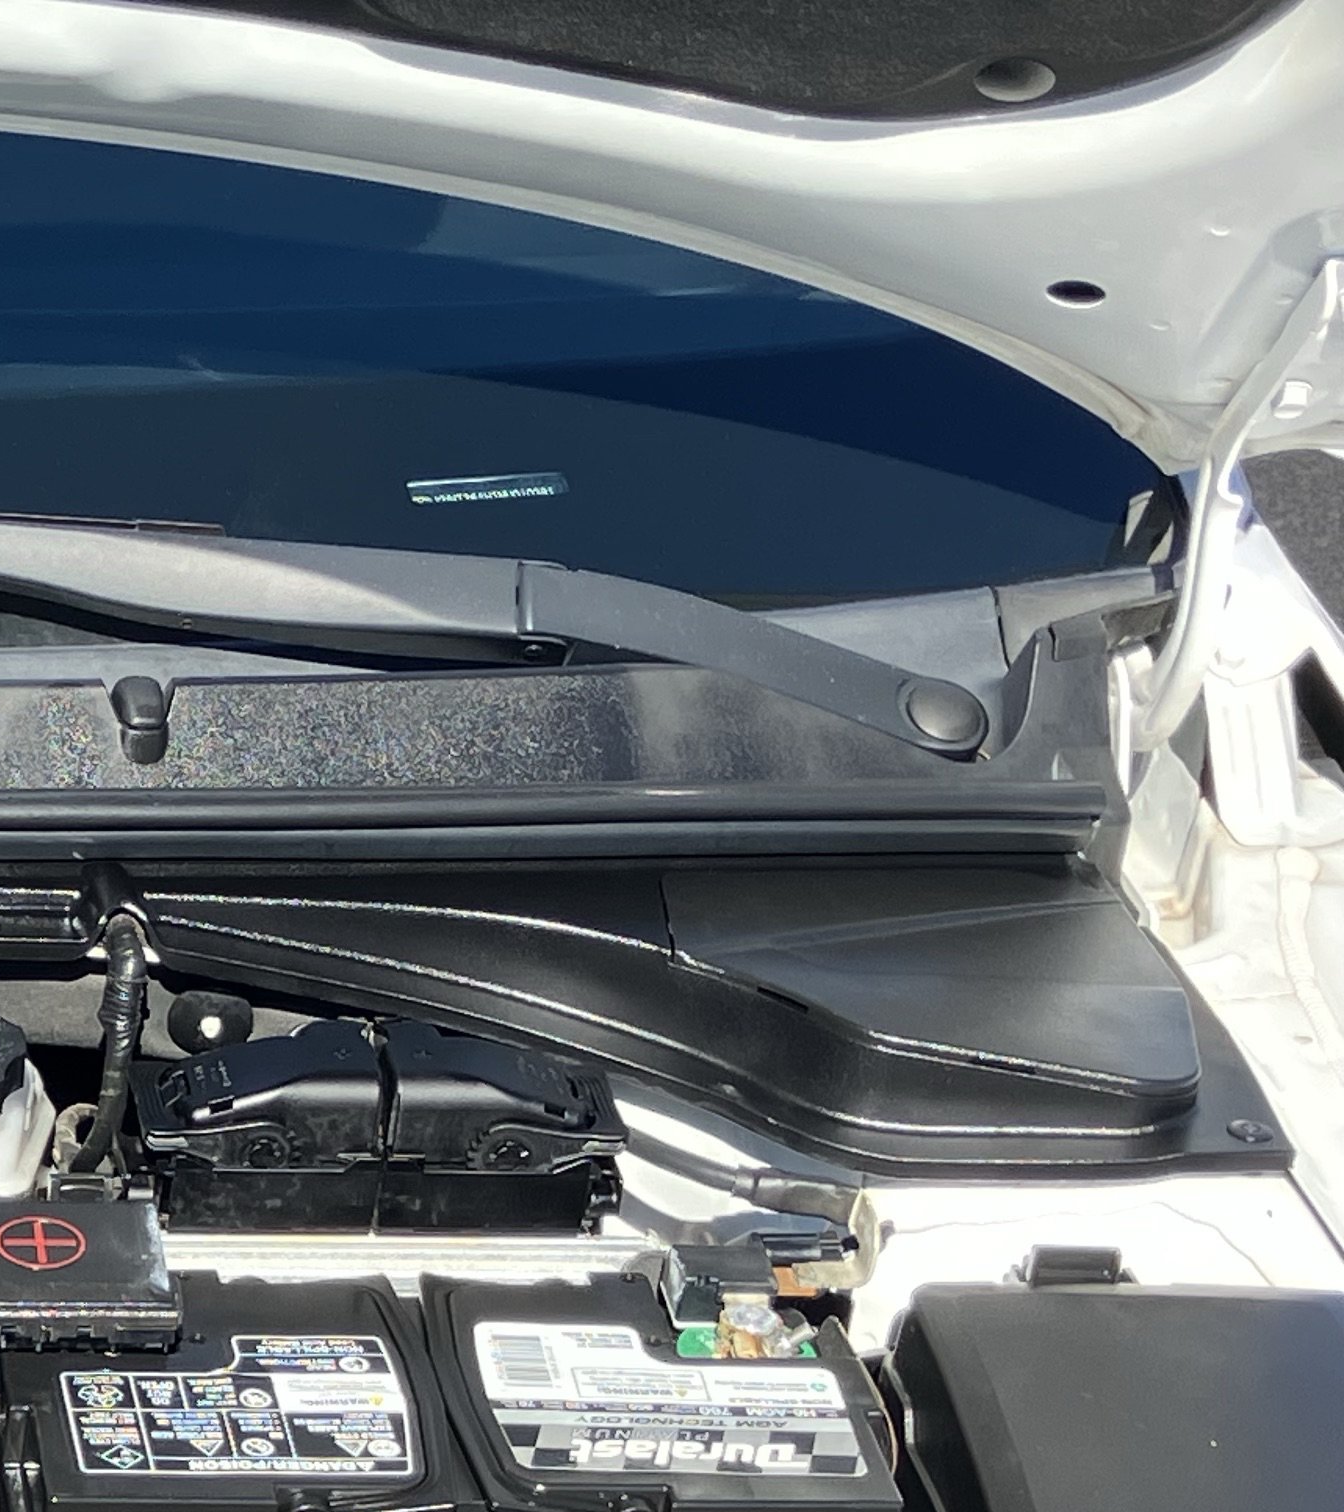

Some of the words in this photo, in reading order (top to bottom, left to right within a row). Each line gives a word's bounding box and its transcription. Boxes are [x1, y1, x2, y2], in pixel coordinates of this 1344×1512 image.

[573, 1415, 728, 1428] TECHNOLOGY
[735, 1420, 788, 1429] AGM
[571, 1428, 711, 1441] PLATINUM
[569, 1438, 810, 1468] Duralast
